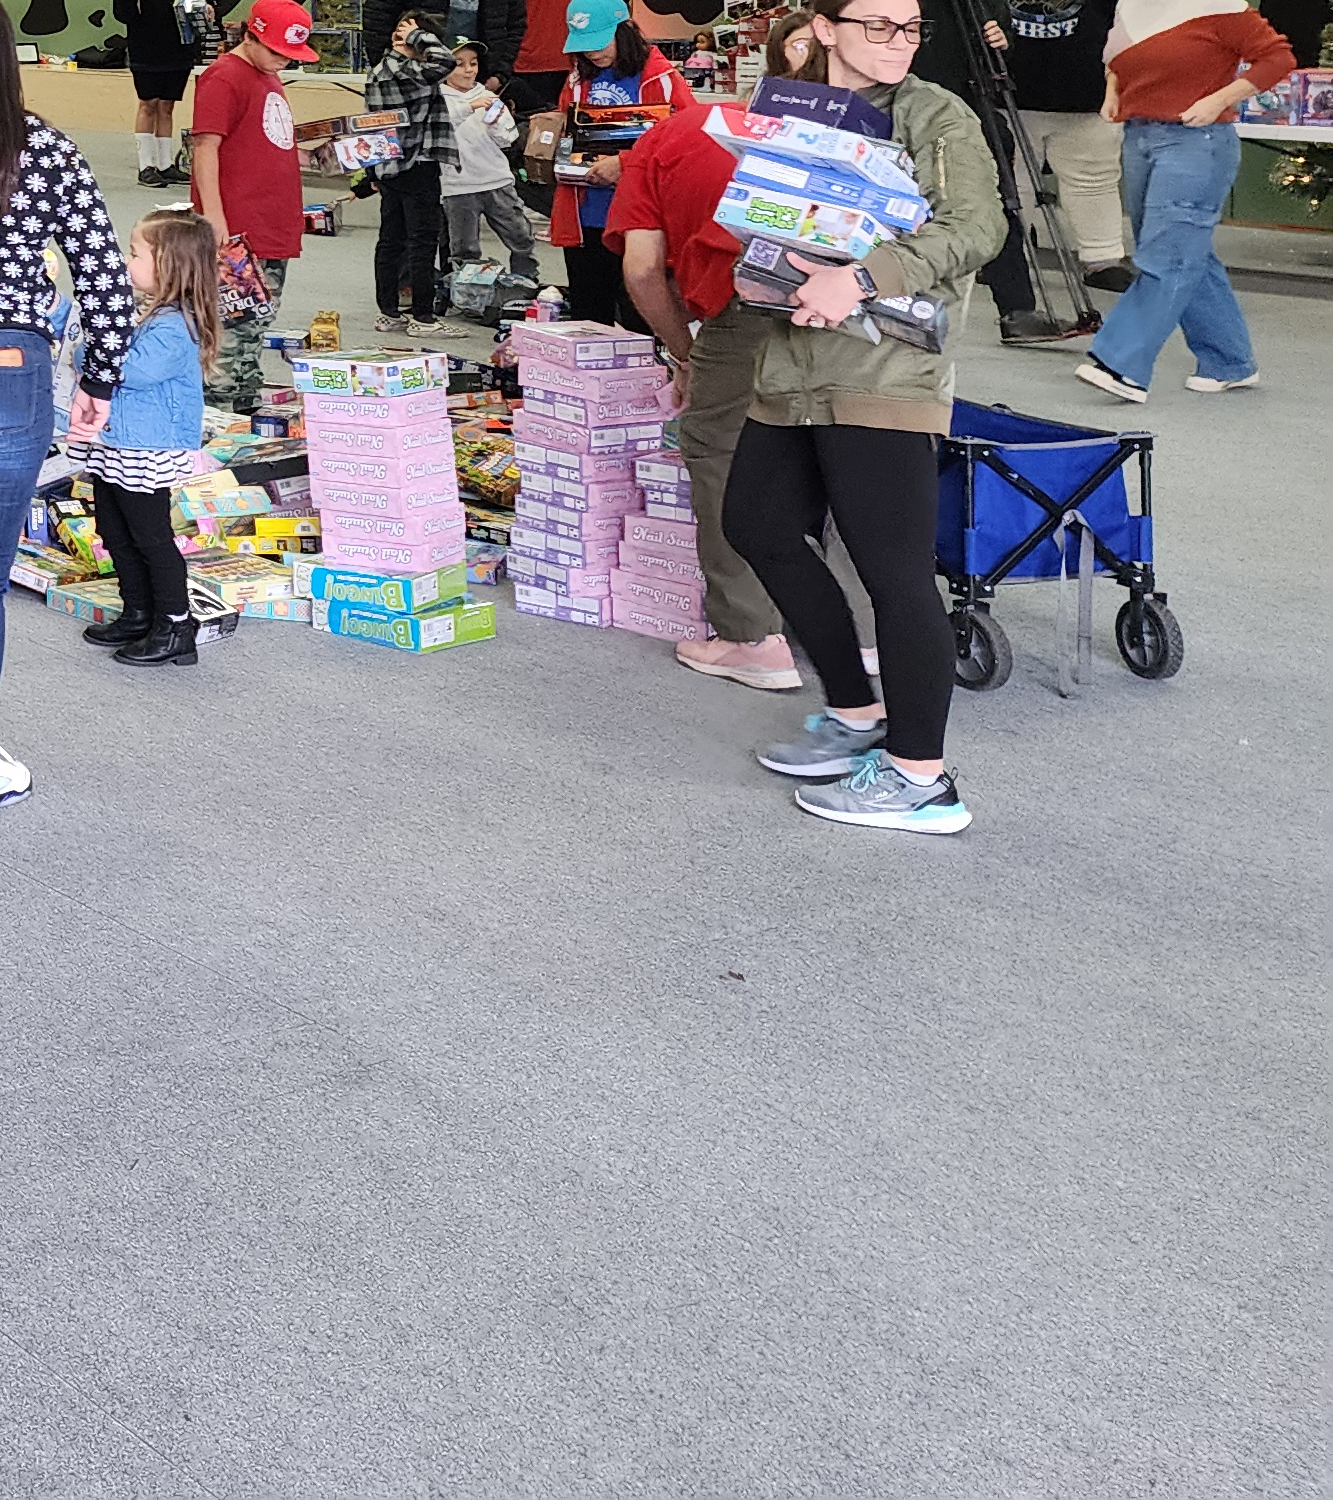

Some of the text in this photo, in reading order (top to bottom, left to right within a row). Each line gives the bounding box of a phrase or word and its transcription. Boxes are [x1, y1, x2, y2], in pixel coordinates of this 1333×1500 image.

[527, 366, 585, 390] Nail Studio
[318, 400, 389, 418] Nail Studio
[319, 430, 384, 450] Nail Studio
[321, 459, 387, 480] Nail Studio
[323, 488, 388, 510] Nail Studio
[335, 515, 405, 537] Nail Studio
[633, 525, 665, 542] Nail
[338, 543, 412, 565] Nail Studio
[324, 573, 408, 614] BINGO!
[340, 608, 415, 649] BINGO!
